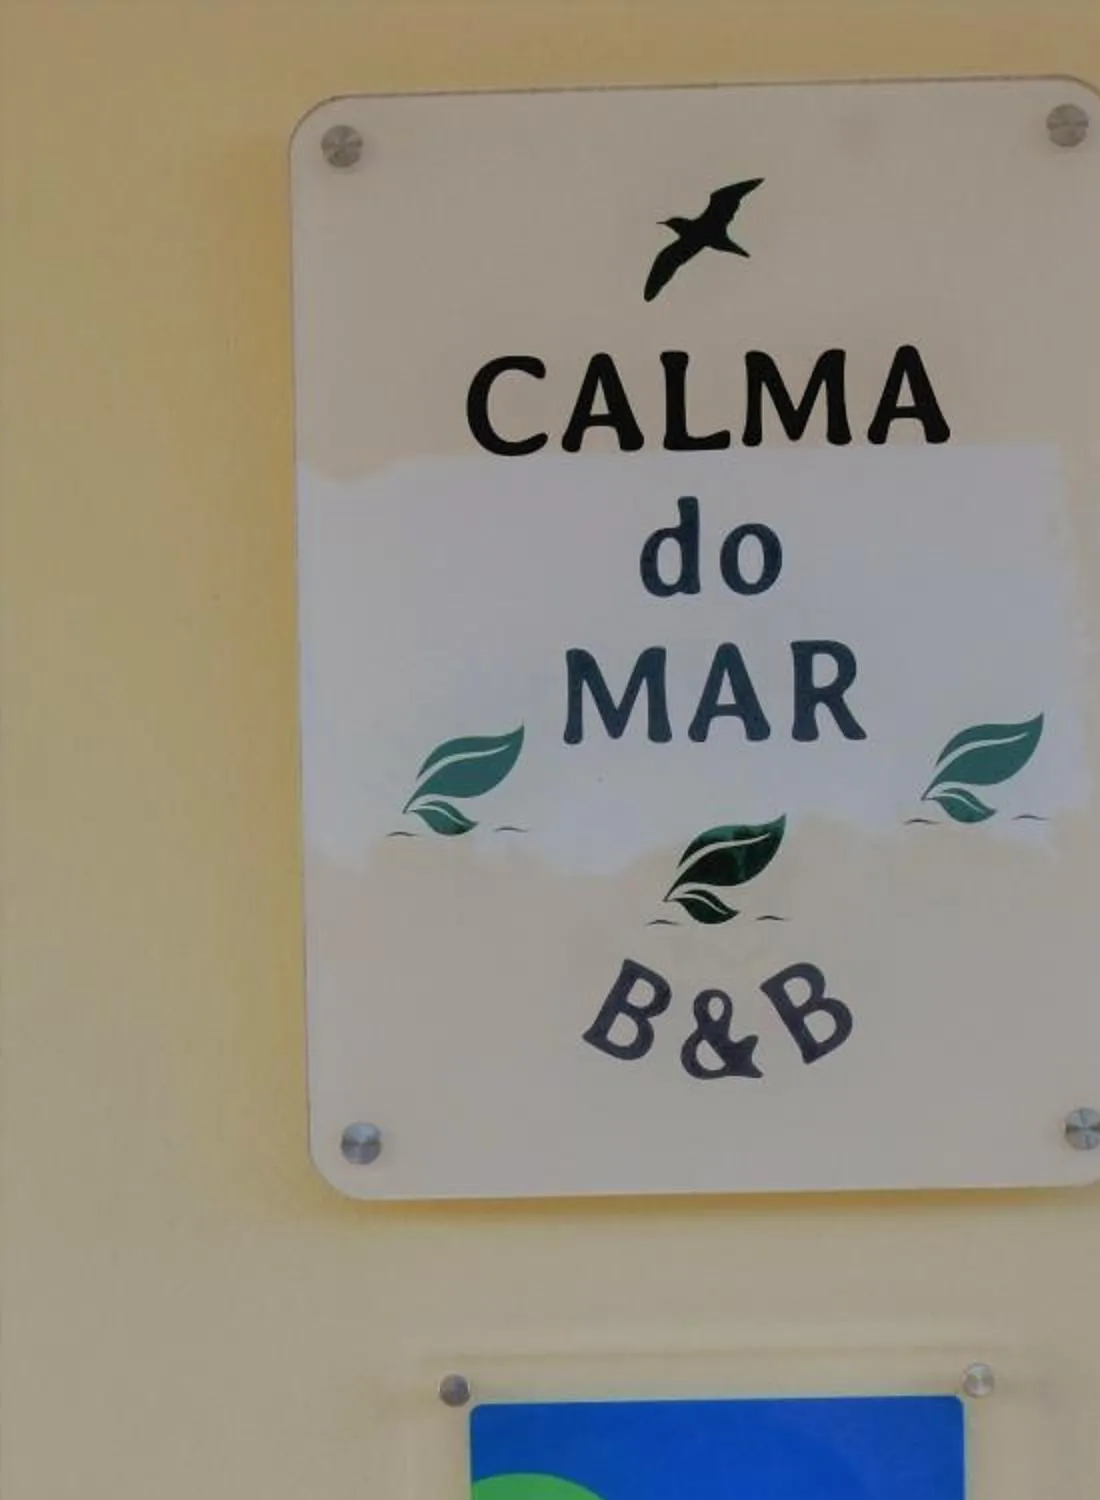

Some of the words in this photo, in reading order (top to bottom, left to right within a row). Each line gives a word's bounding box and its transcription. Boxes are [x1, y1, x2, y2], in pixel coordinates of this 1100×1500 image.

[467, 344, 951, 457] CALMA
[638, 494, 784, 598] do
[562, 638, 868, 746] MAR
[581, 958, 854, 1081] B&B
